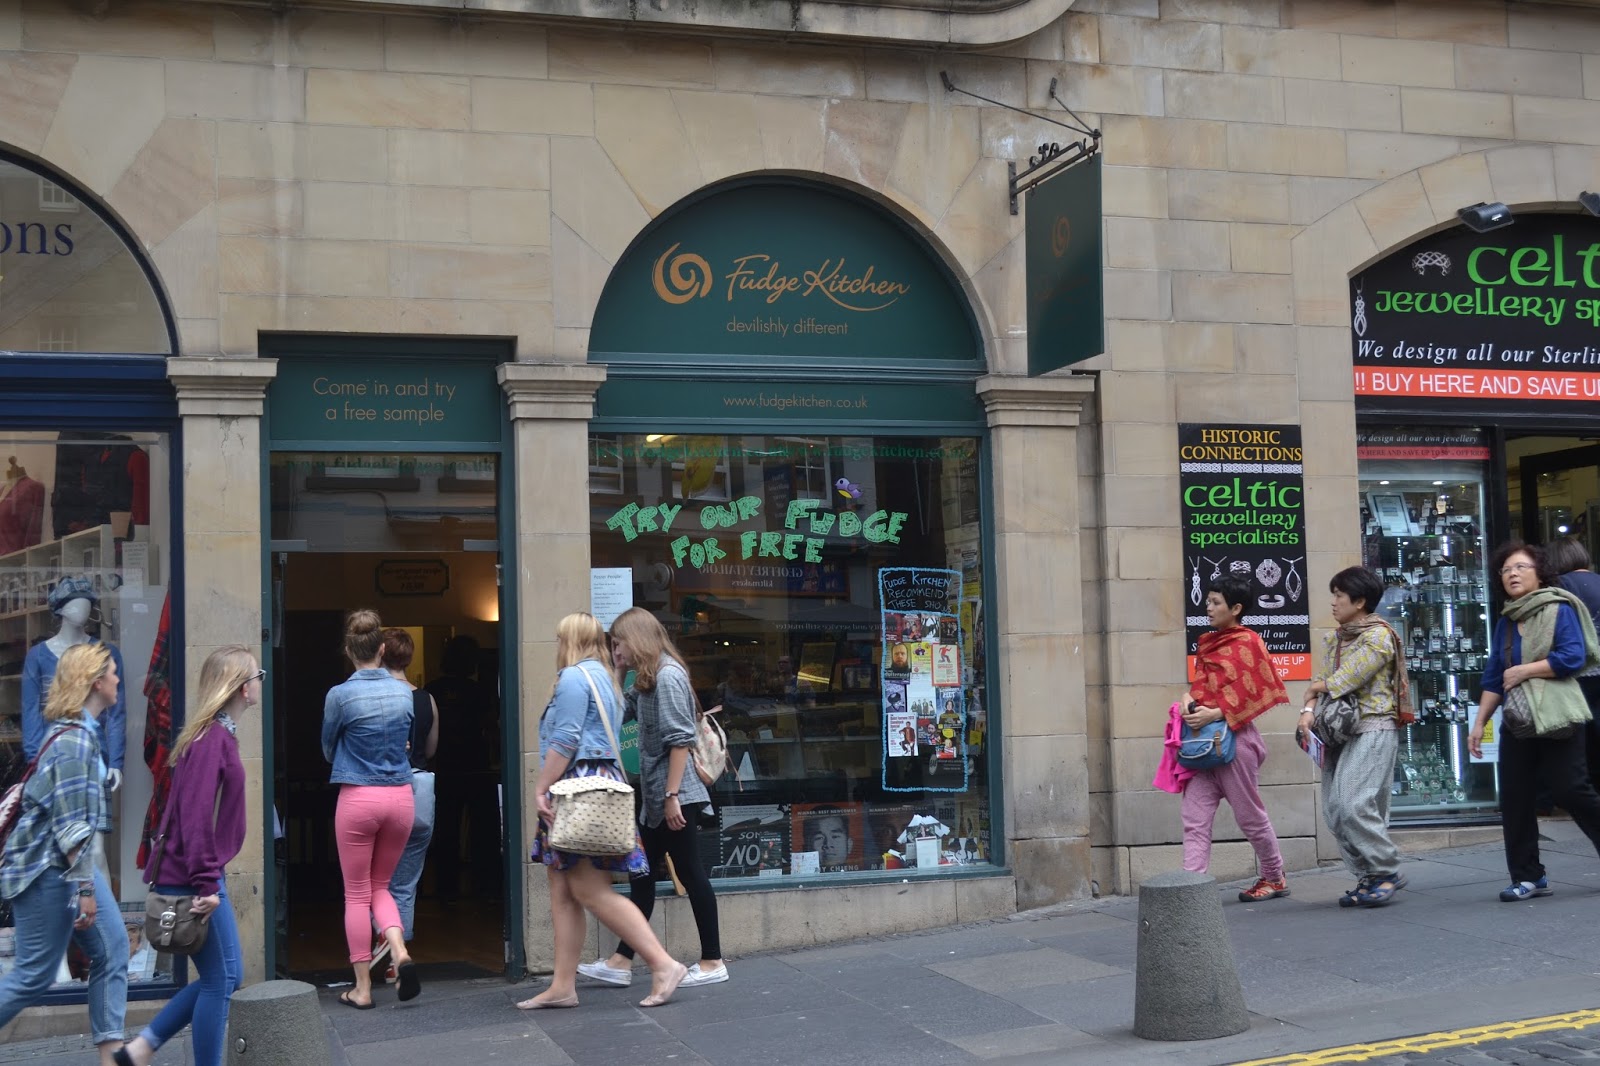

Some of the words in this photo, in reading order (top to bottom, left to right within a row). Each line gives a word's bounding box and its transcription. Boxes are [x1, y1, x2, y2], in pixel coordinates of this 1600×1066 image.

[725, 253, 800, 304] Fudge
[802, 257, 910, 312] Kitchen
[726, 315, 789, 338] devilishly
[793, 317, 849, 335] different
[1357, 340, 1384, 358] We
[1392, 341, 1457, 364] design
[1466, 344, 1493, 361] all
[1501, 349, 1534, 363] our
[313, 377, 366, 397] Come
[374, 378, 388, 396] in
[395, 378, 428, 397] and
[435, 380, 456, 401] try
[1372, 372, 1414, 391] BUY
[1420, 375, 1475, 394] HERE
[1480, 376, 1522, 394] AND
[1527, 377, 1578, 396] SAVE
[1583, 379, 1600, 396] U
[723, 393, 868, 411] www.fudgekitchen.co.uk
[326, 407, 337, 420] a
[344, 403, 377, 421] free
[383, 404, 445, 425] sample
[1201, 429, 1281, 445] HISTORIC
[1368, 434, 1394, 444] design
[1396, 434, 1407, 442] all
[1441, 434, 1478, 444] jewellery
[1181, 445, 1302, 462] CONNECTIONS
[605, 501, 683, 543] TRY
[700, 496, 762, 530] OUR
[784, 498, 908, 545] FUDGE
[671, 535, 727, 568] FOR
[740, 531, 825, 563] FREE
[882, 572, 907, 590] FUDGE
[912, 569, 951, 588] KITCHEN
[887, 588, 950, 600] RECOMMENDS
[888, 599, 916, 610] THESE
[925, 601, 952, 614] SHOWS
[1258, 629, 1270, 639] all
[1273, 631, 1289, 639] our
[1272, 656, 1291, 666] AVE
[1292, 656, 1305, 666] UP
[1277, 668, 1290, 676] RP
